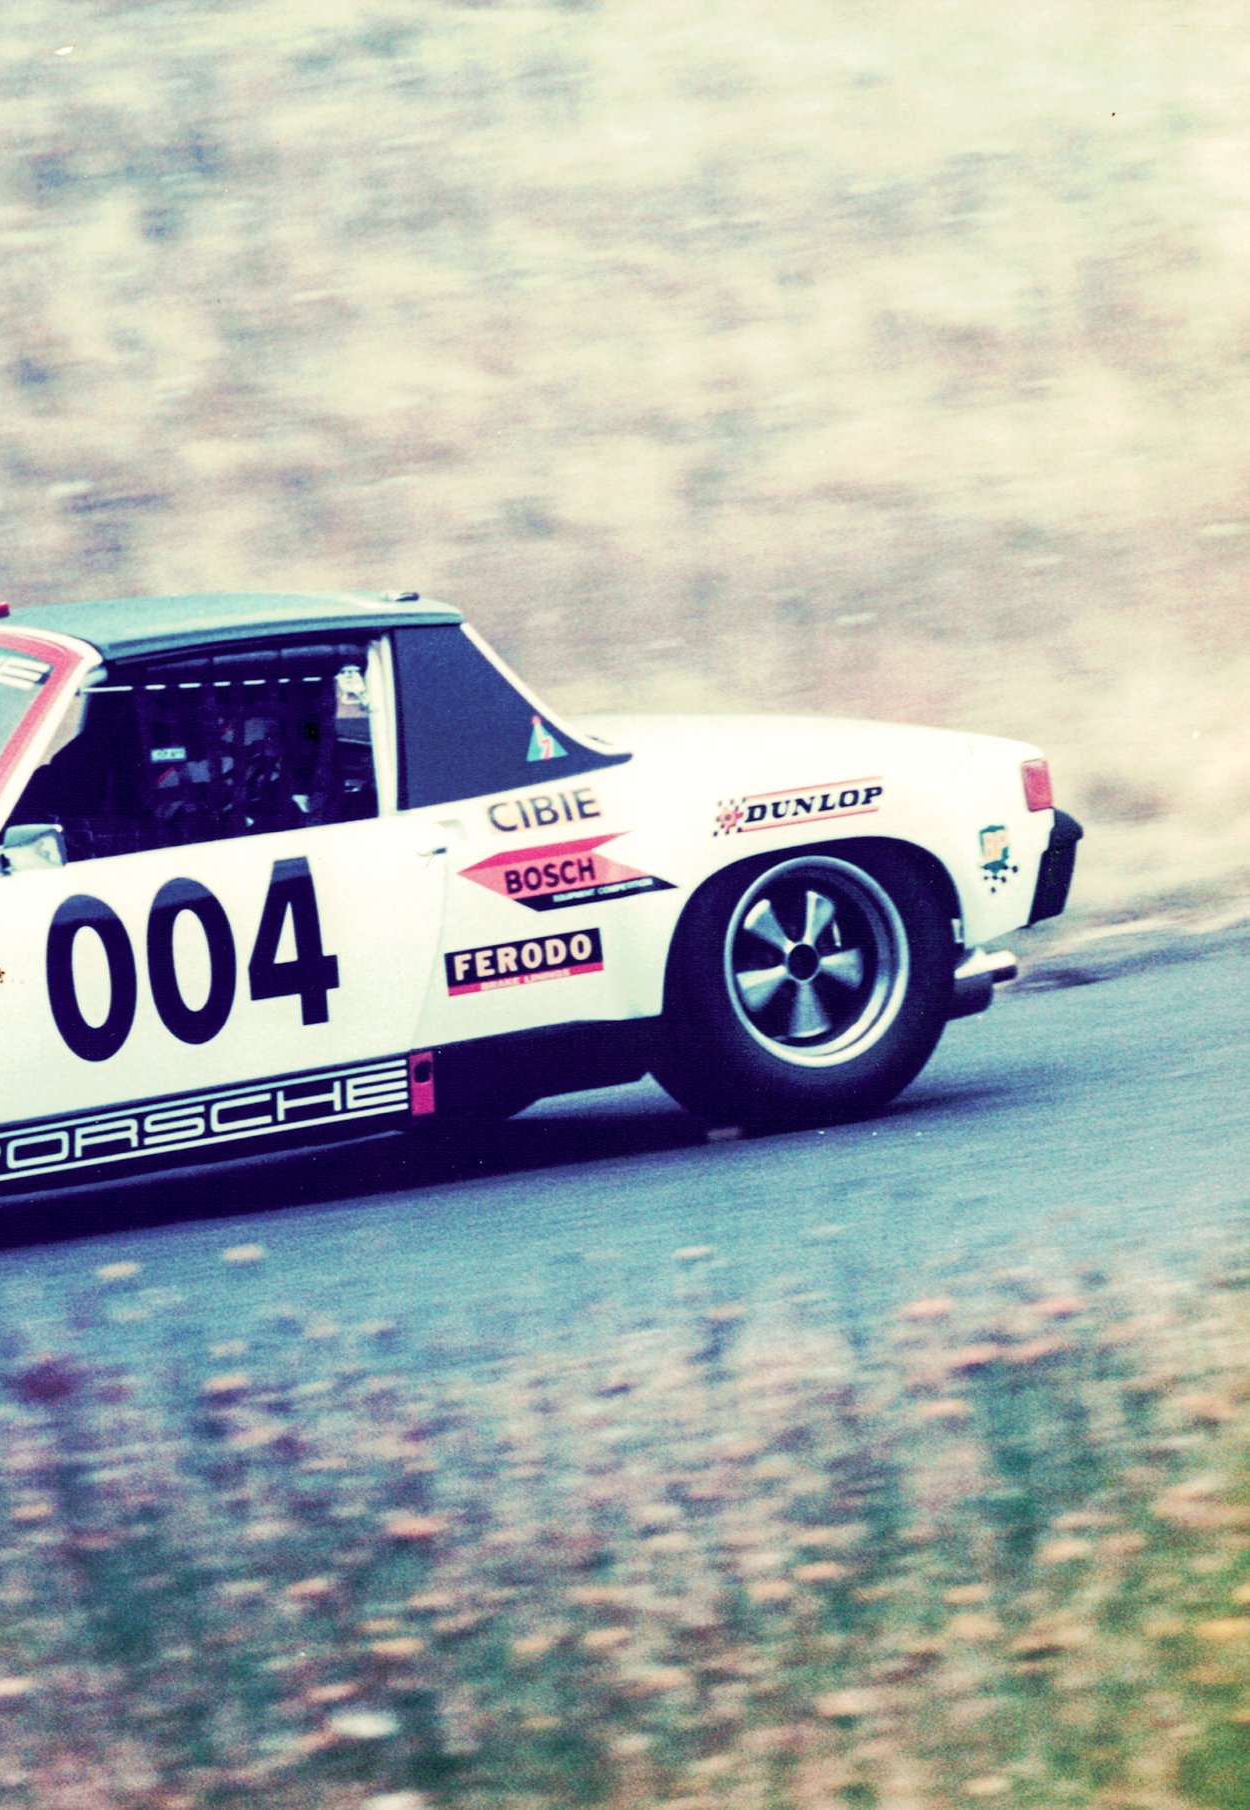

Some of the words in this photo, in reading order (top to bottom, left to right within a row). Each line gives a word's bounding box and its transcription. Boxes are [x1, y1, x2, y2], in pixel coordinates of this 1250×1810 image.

[487, 787, 601, 832] CIBIE
[745, 786, 883, 823] DUNLOP
[505, 857, 596, 894] BOSCH
[46, 855, 340, 1063] 004
[454, 935, 592, 981] FERODO
